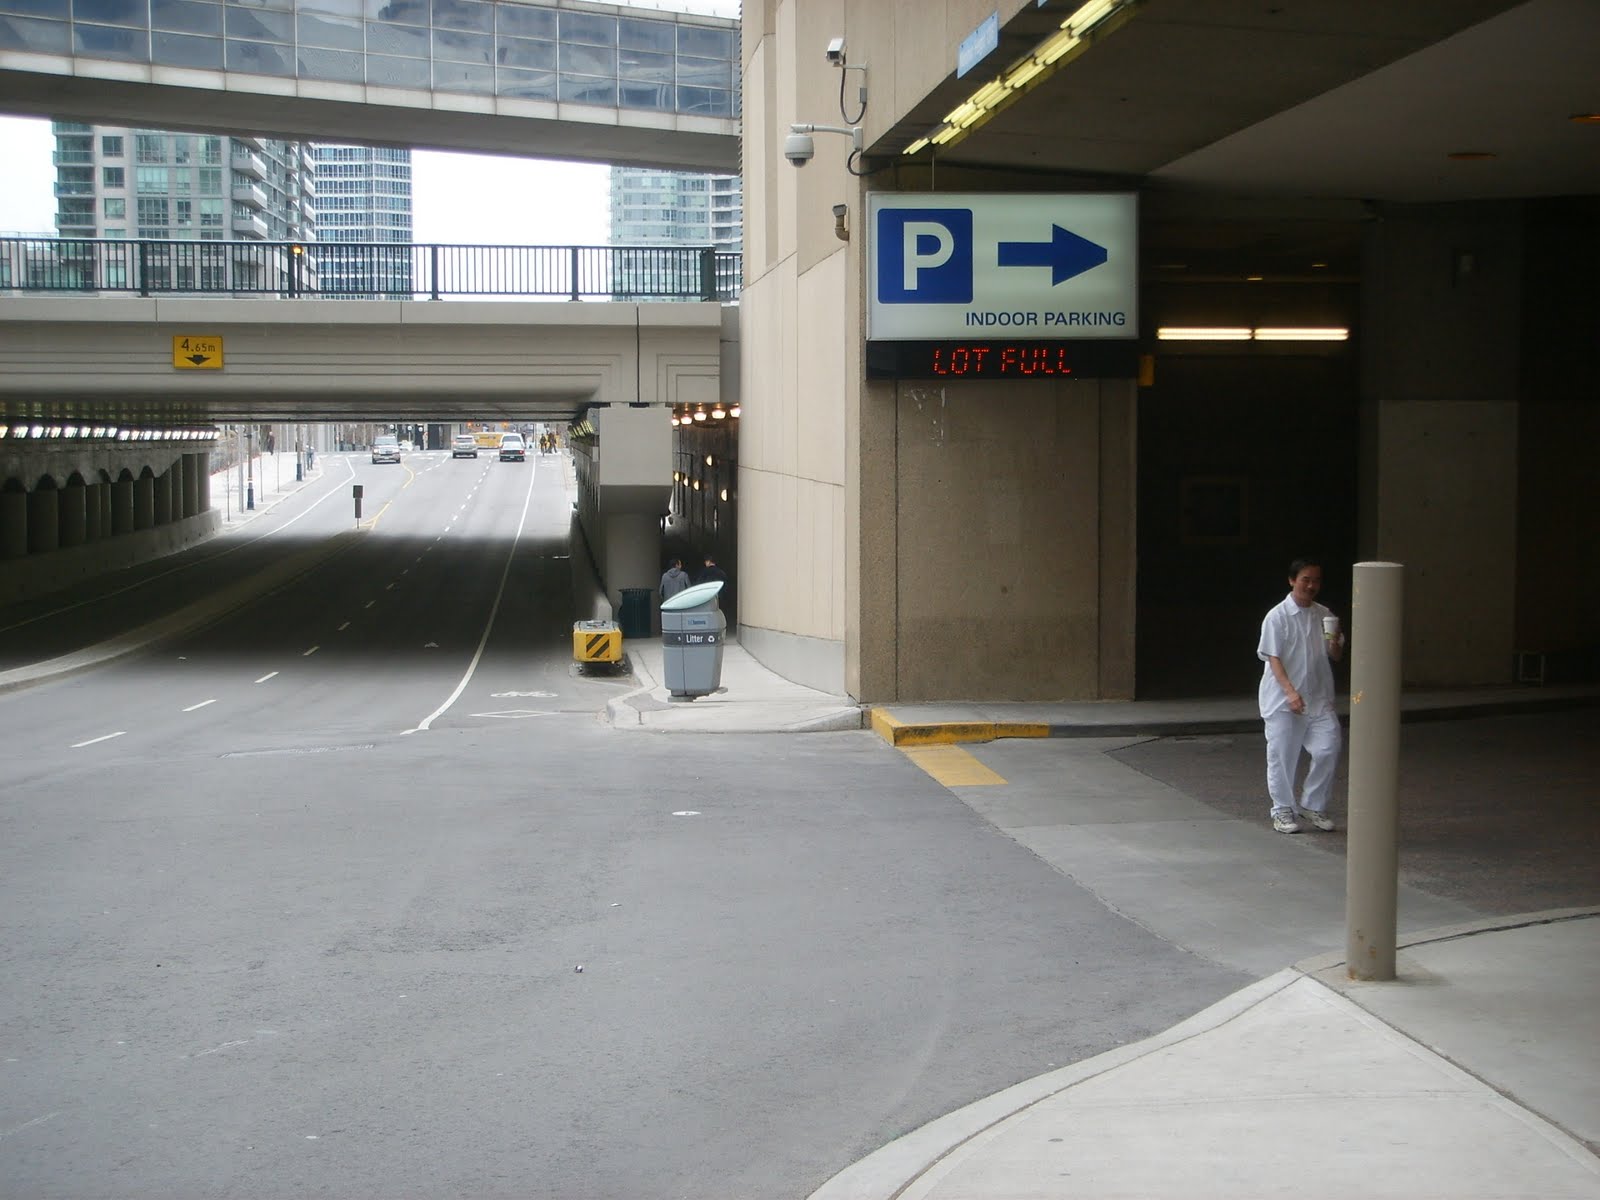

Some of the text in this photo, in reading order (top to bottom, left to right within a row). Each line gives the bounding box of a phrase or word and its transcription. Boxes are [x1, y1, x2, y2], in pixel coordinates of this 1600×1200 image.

[904, 221, 954, 290] P
[966, 312, 1126, 326] INDOOR PARKING
[181, 338, 216, 352] 4.65m
[934, 348, 1072, 374] LOT FULL
[686, 634, 704, 643] Litter
